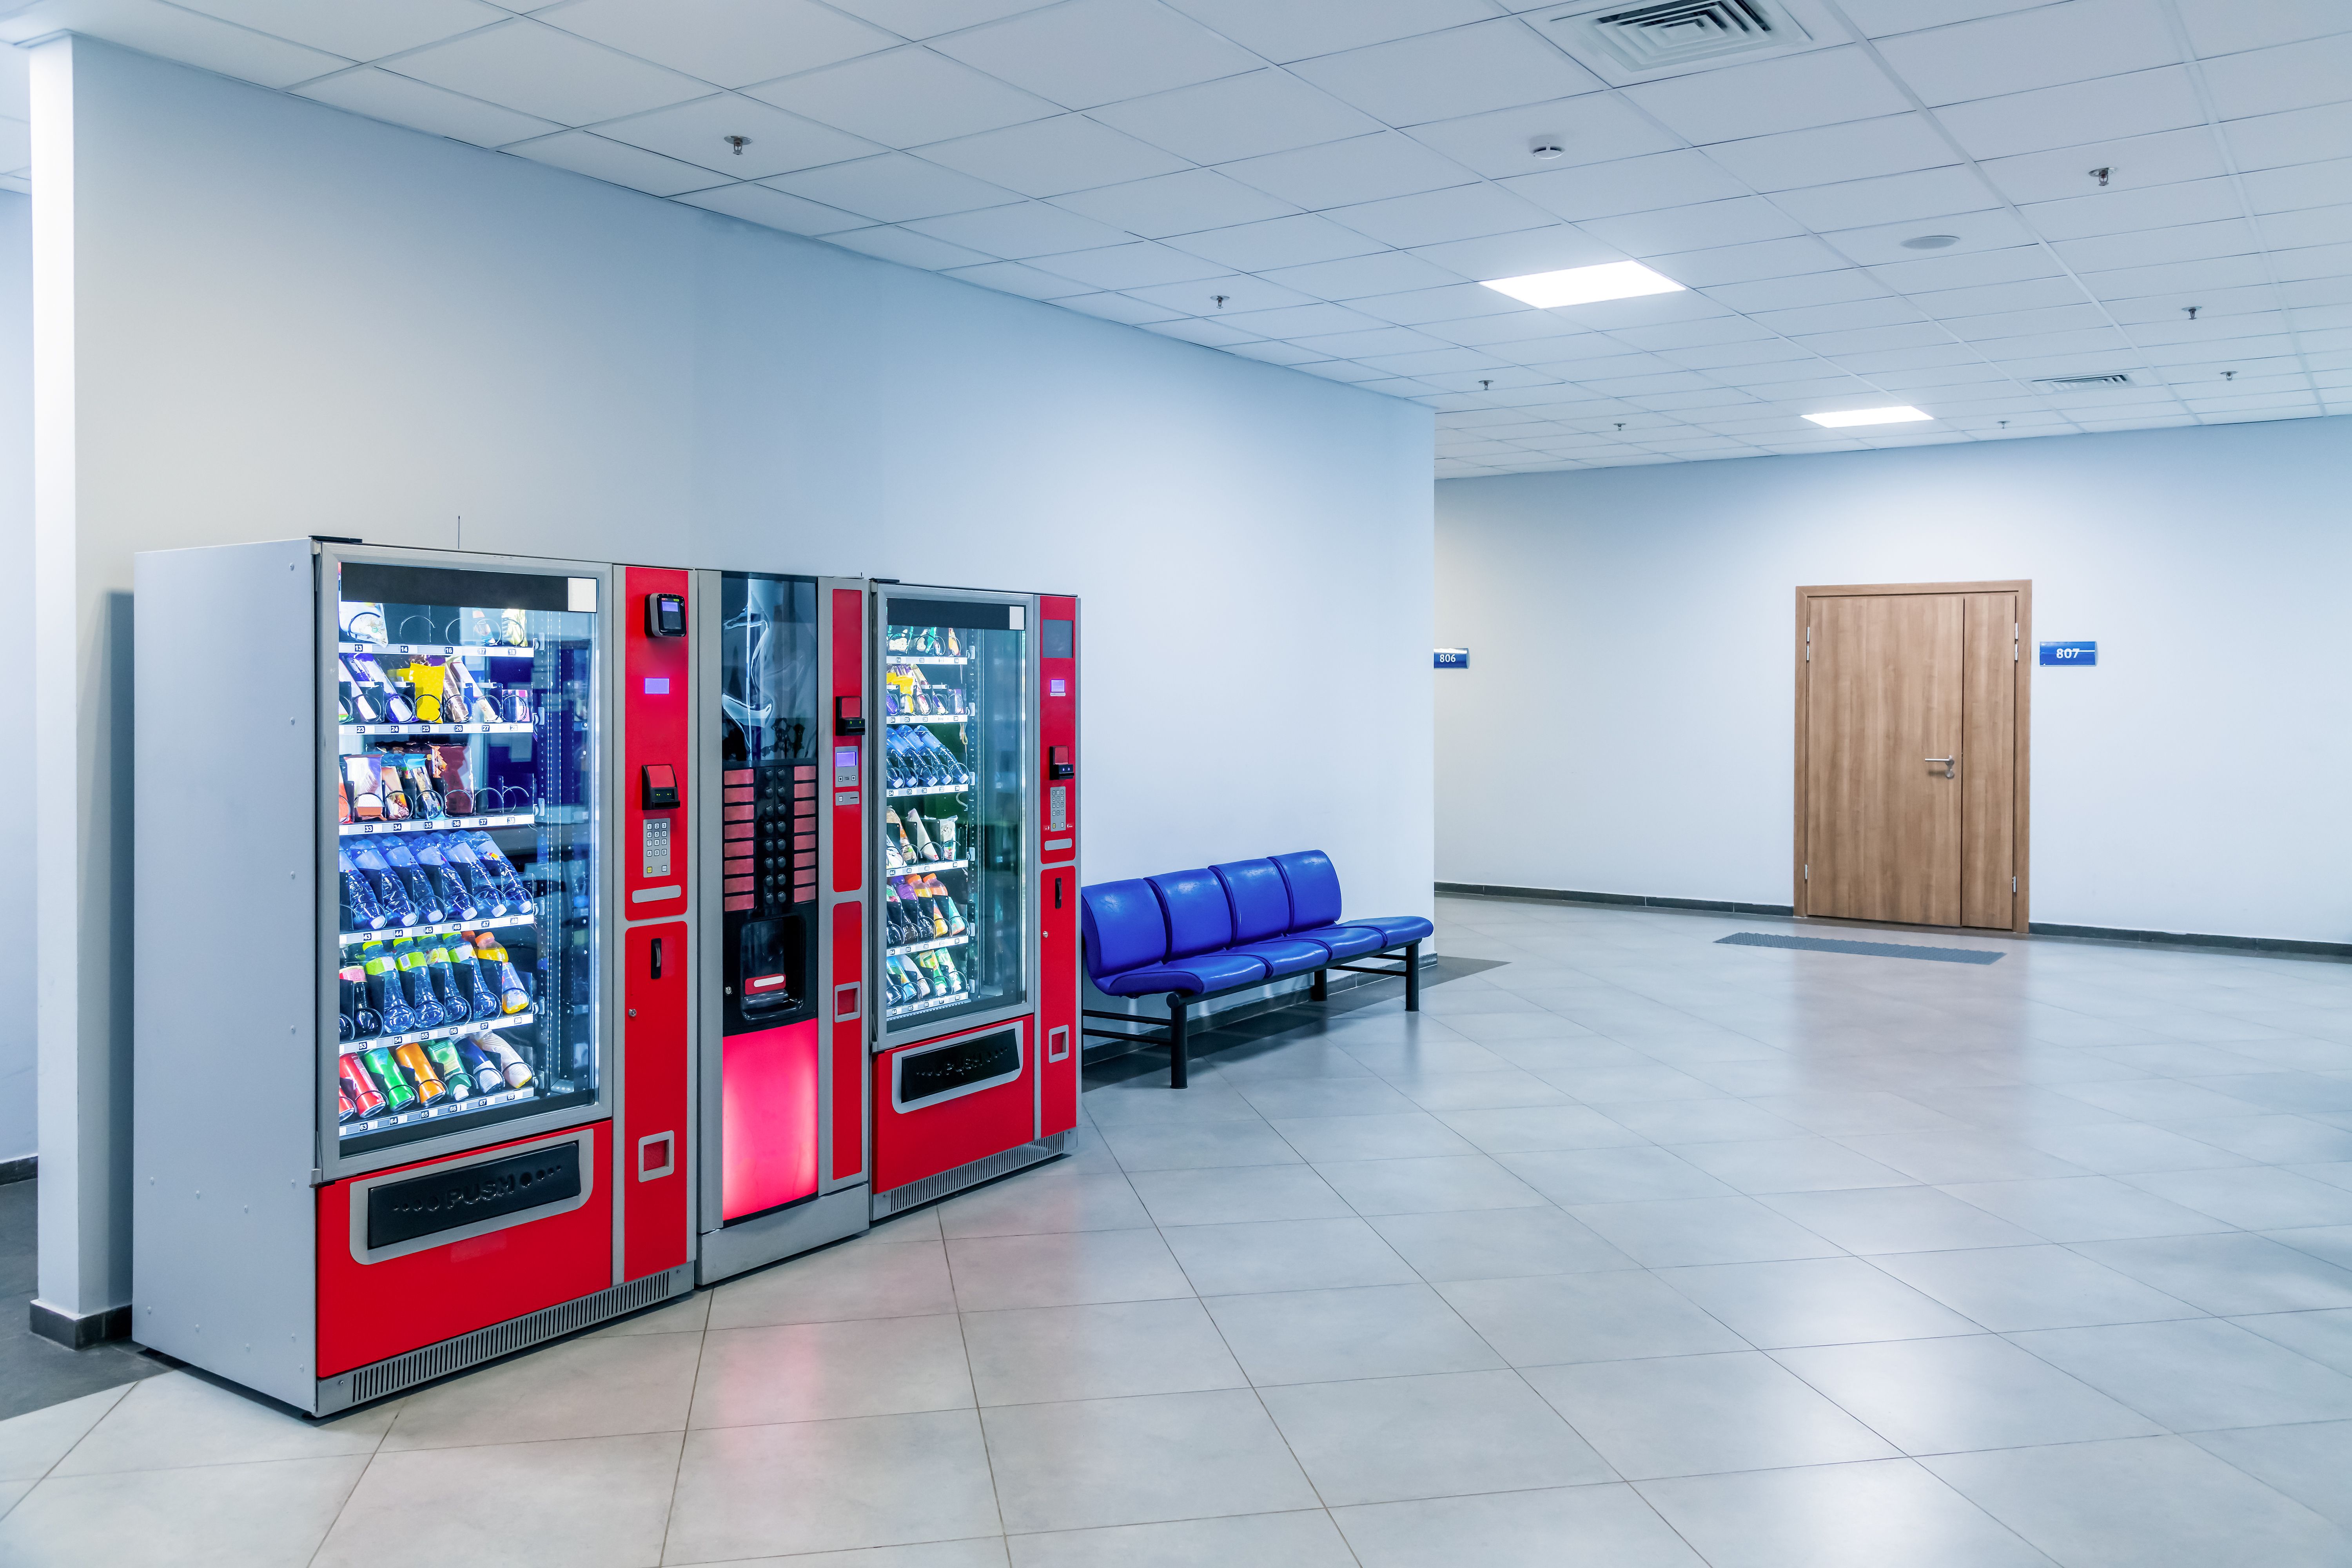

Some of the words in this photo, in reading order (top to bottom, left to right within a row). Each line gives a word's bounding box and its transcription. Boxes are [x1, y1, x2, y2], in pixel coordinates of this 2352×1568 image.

[1439, 654, 1456, 663] 806
[2056, 648, 2080, 659] 807
[944, 1052, 983, 1076] PUSH
[446, 1172, 516, 1210] PUSH
